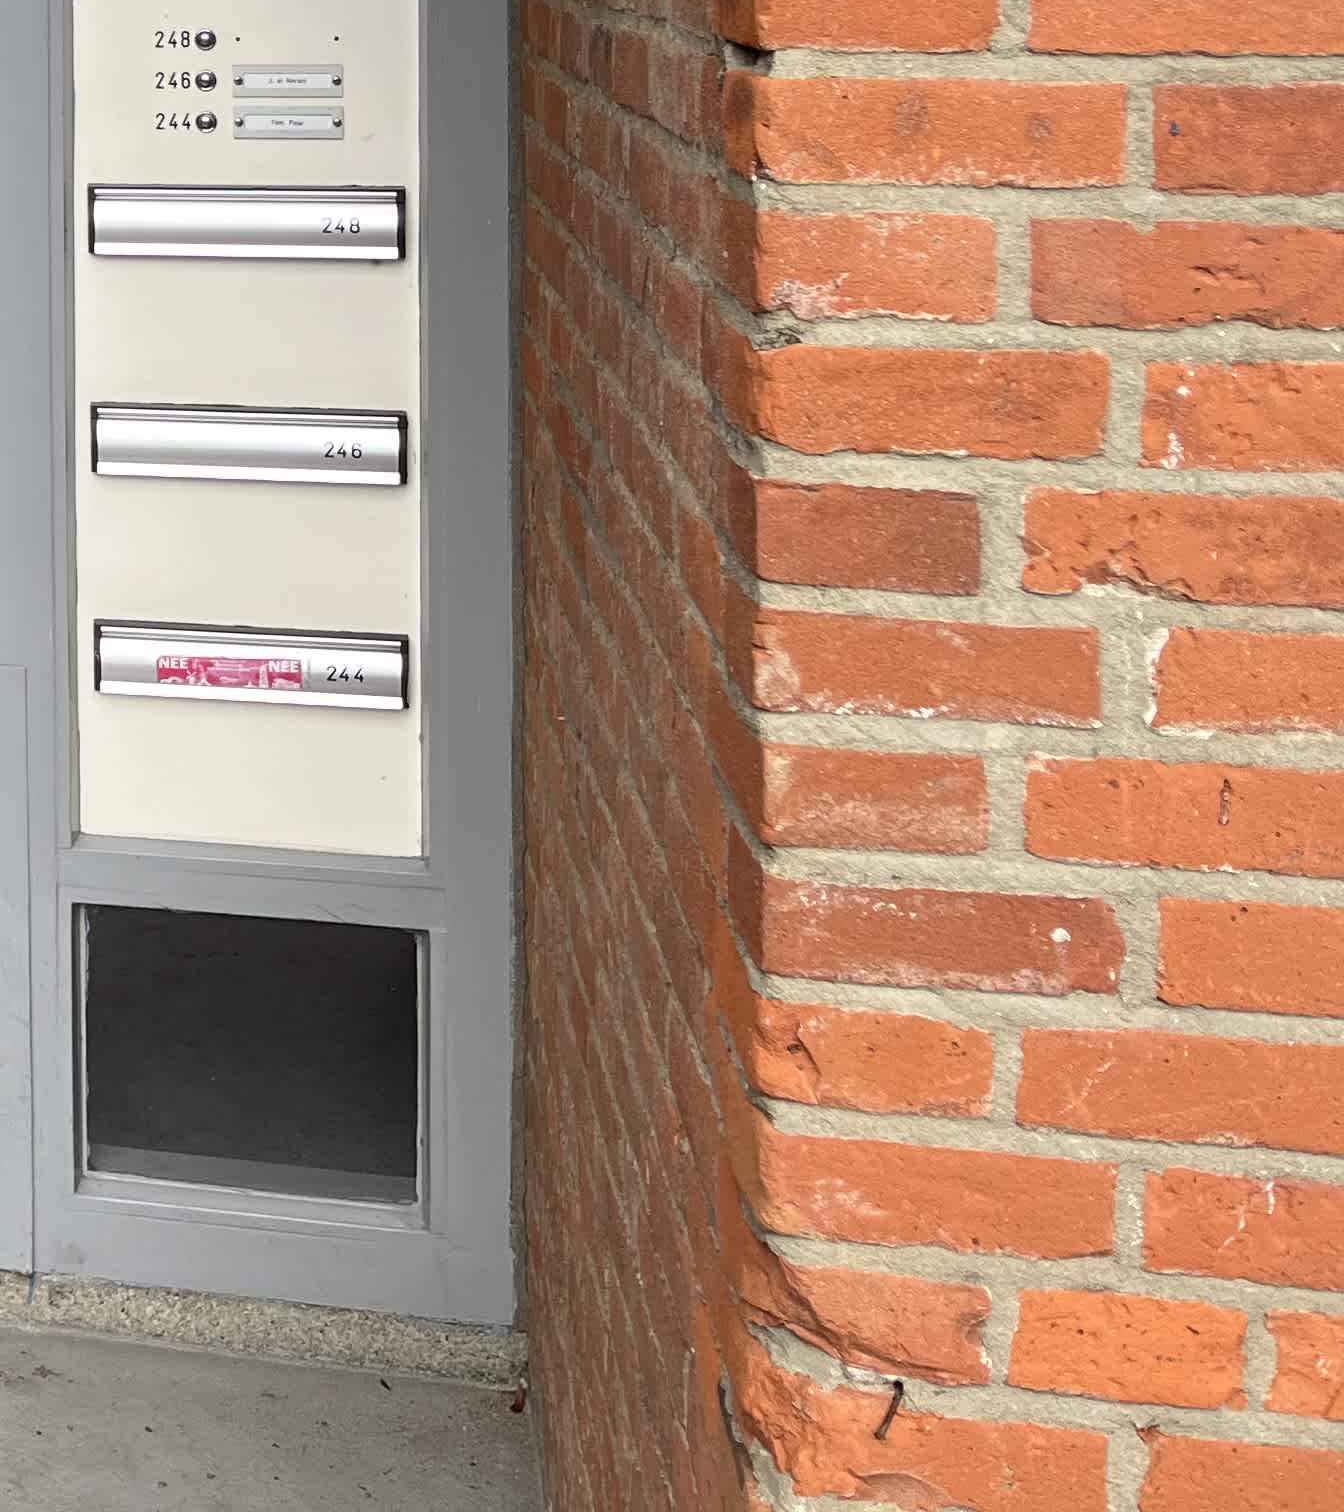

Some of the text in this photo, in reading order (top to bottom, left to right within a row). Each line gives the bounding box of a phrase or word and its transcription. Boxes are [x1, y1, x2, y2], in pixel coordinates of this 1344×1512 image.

[154, 31, 191, 48] 248
[154, 72, 191, 89] 246
[155, 113, 192, 130] 244
[321, 217, 361, 235] 248
[324, 441, 363, 459] 246
[159, 656, 299, 672] NEE NEE
[325, 665, 365, 683] 244
